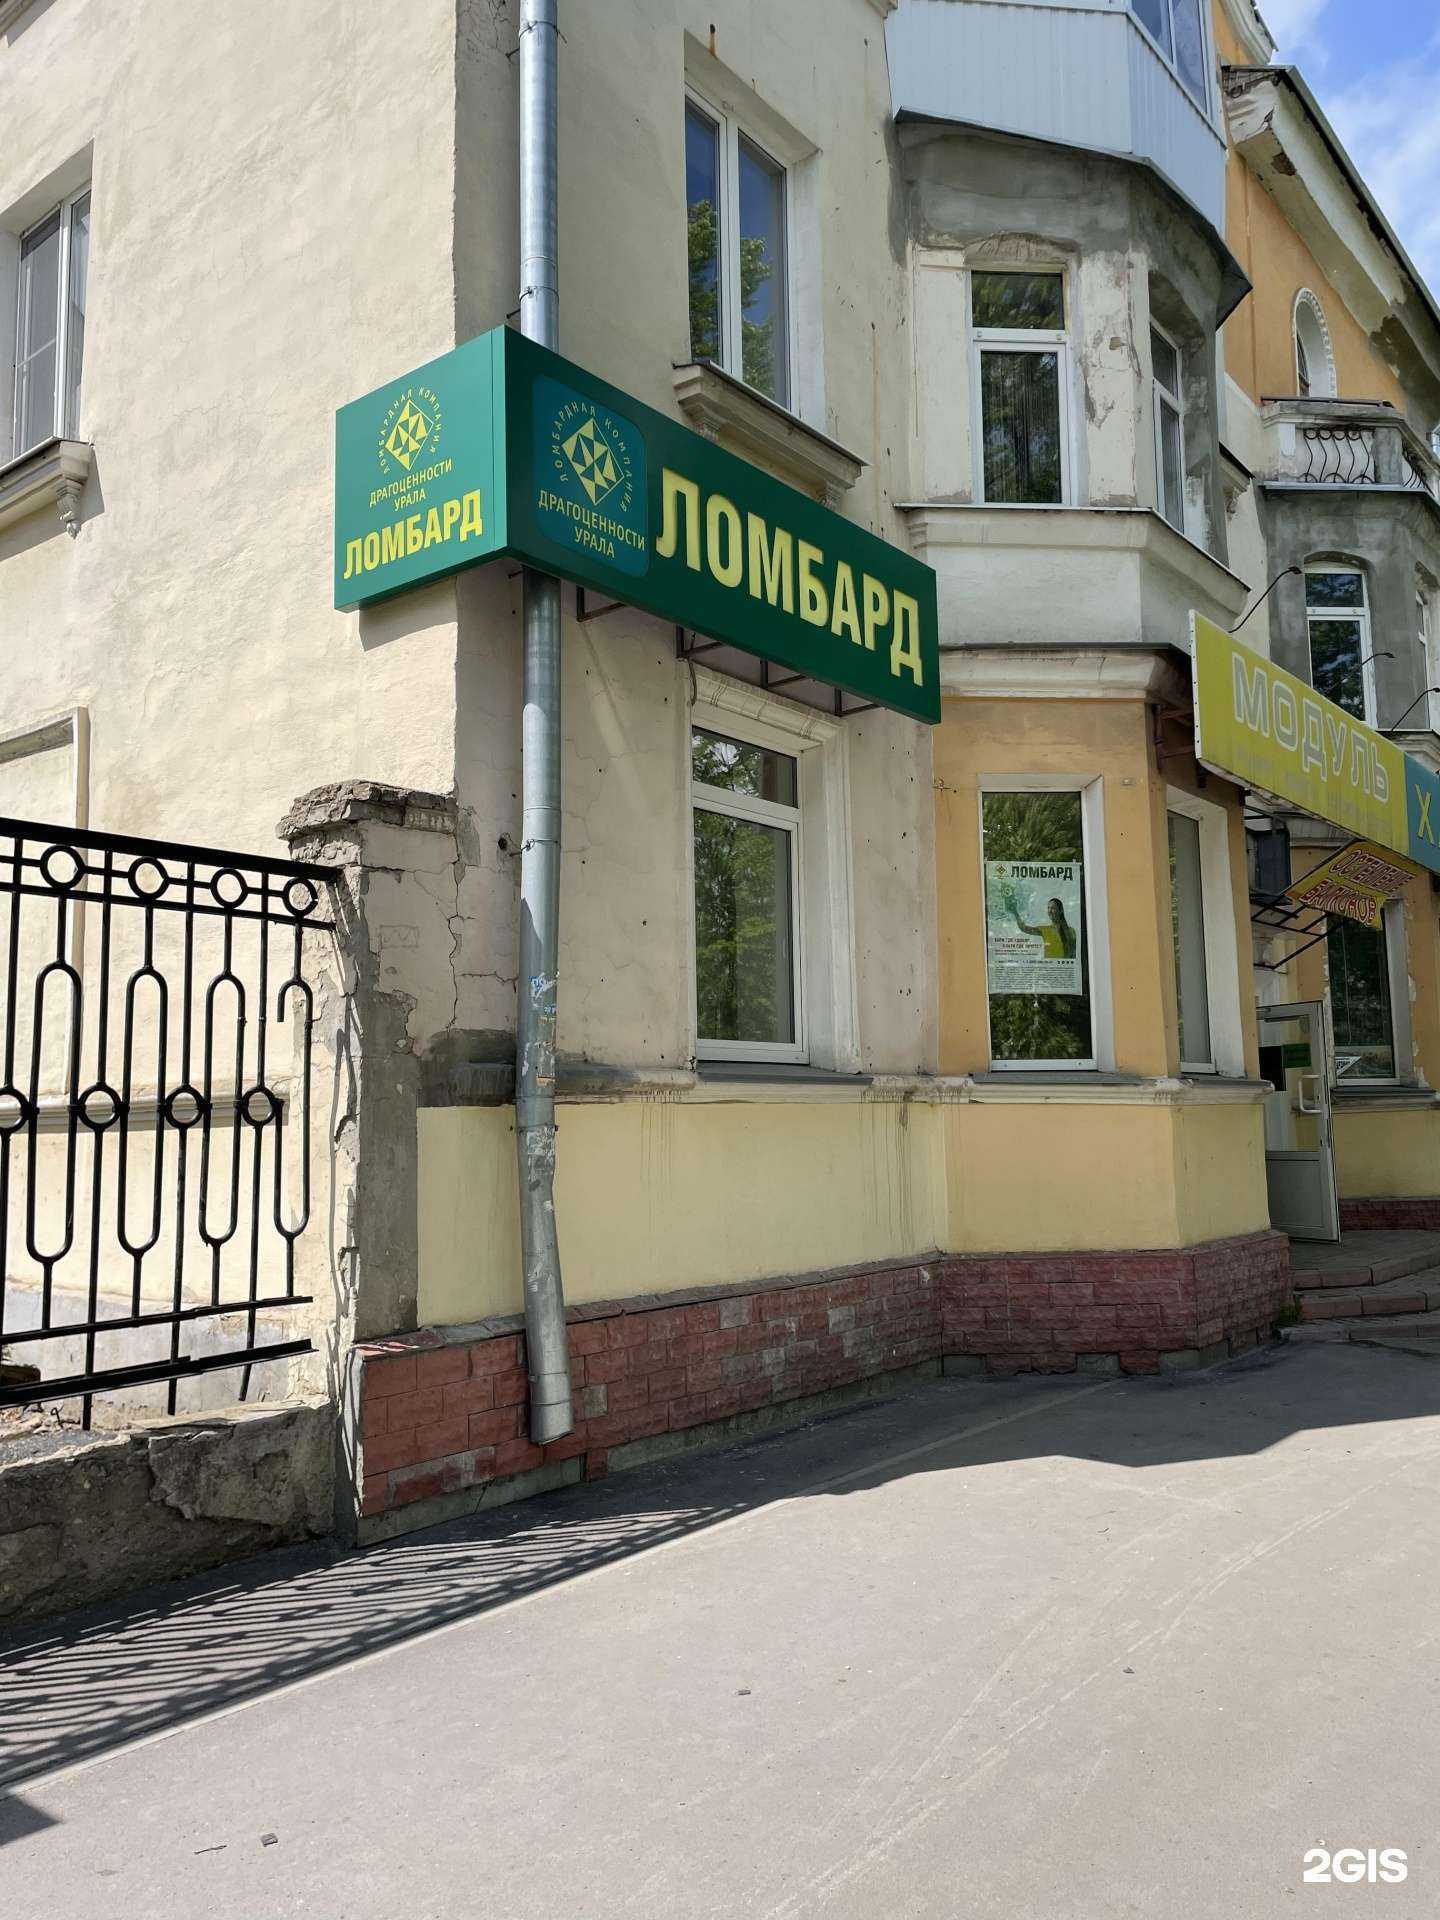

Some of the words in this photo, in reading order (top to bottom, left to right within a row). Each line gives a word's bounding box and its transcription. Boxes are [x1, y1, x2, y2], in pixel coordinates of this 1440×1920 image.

[369, 458, 453, 508] ДРАГОЦЕННОСТИ
[552, 401, 596, 482] ЛОМБАРДНАЯ
[604, 417, 633, 512] КОМПАНИЯ
[393, 490, 426, 511] УРАЛА
[538, 490, 645, 551] ДРАГОЦЕННОСТИ
[343, 489, 483, 579] ЛОМБАРД
[574, 527, 616, 558] УРАЛА
[656, 466, 923, 687] ЛОМБАРД
[1231, 652, 1390, 804] МОДУЛЬ
[1011, 865, 1073, 881] ЛОМБАРД
